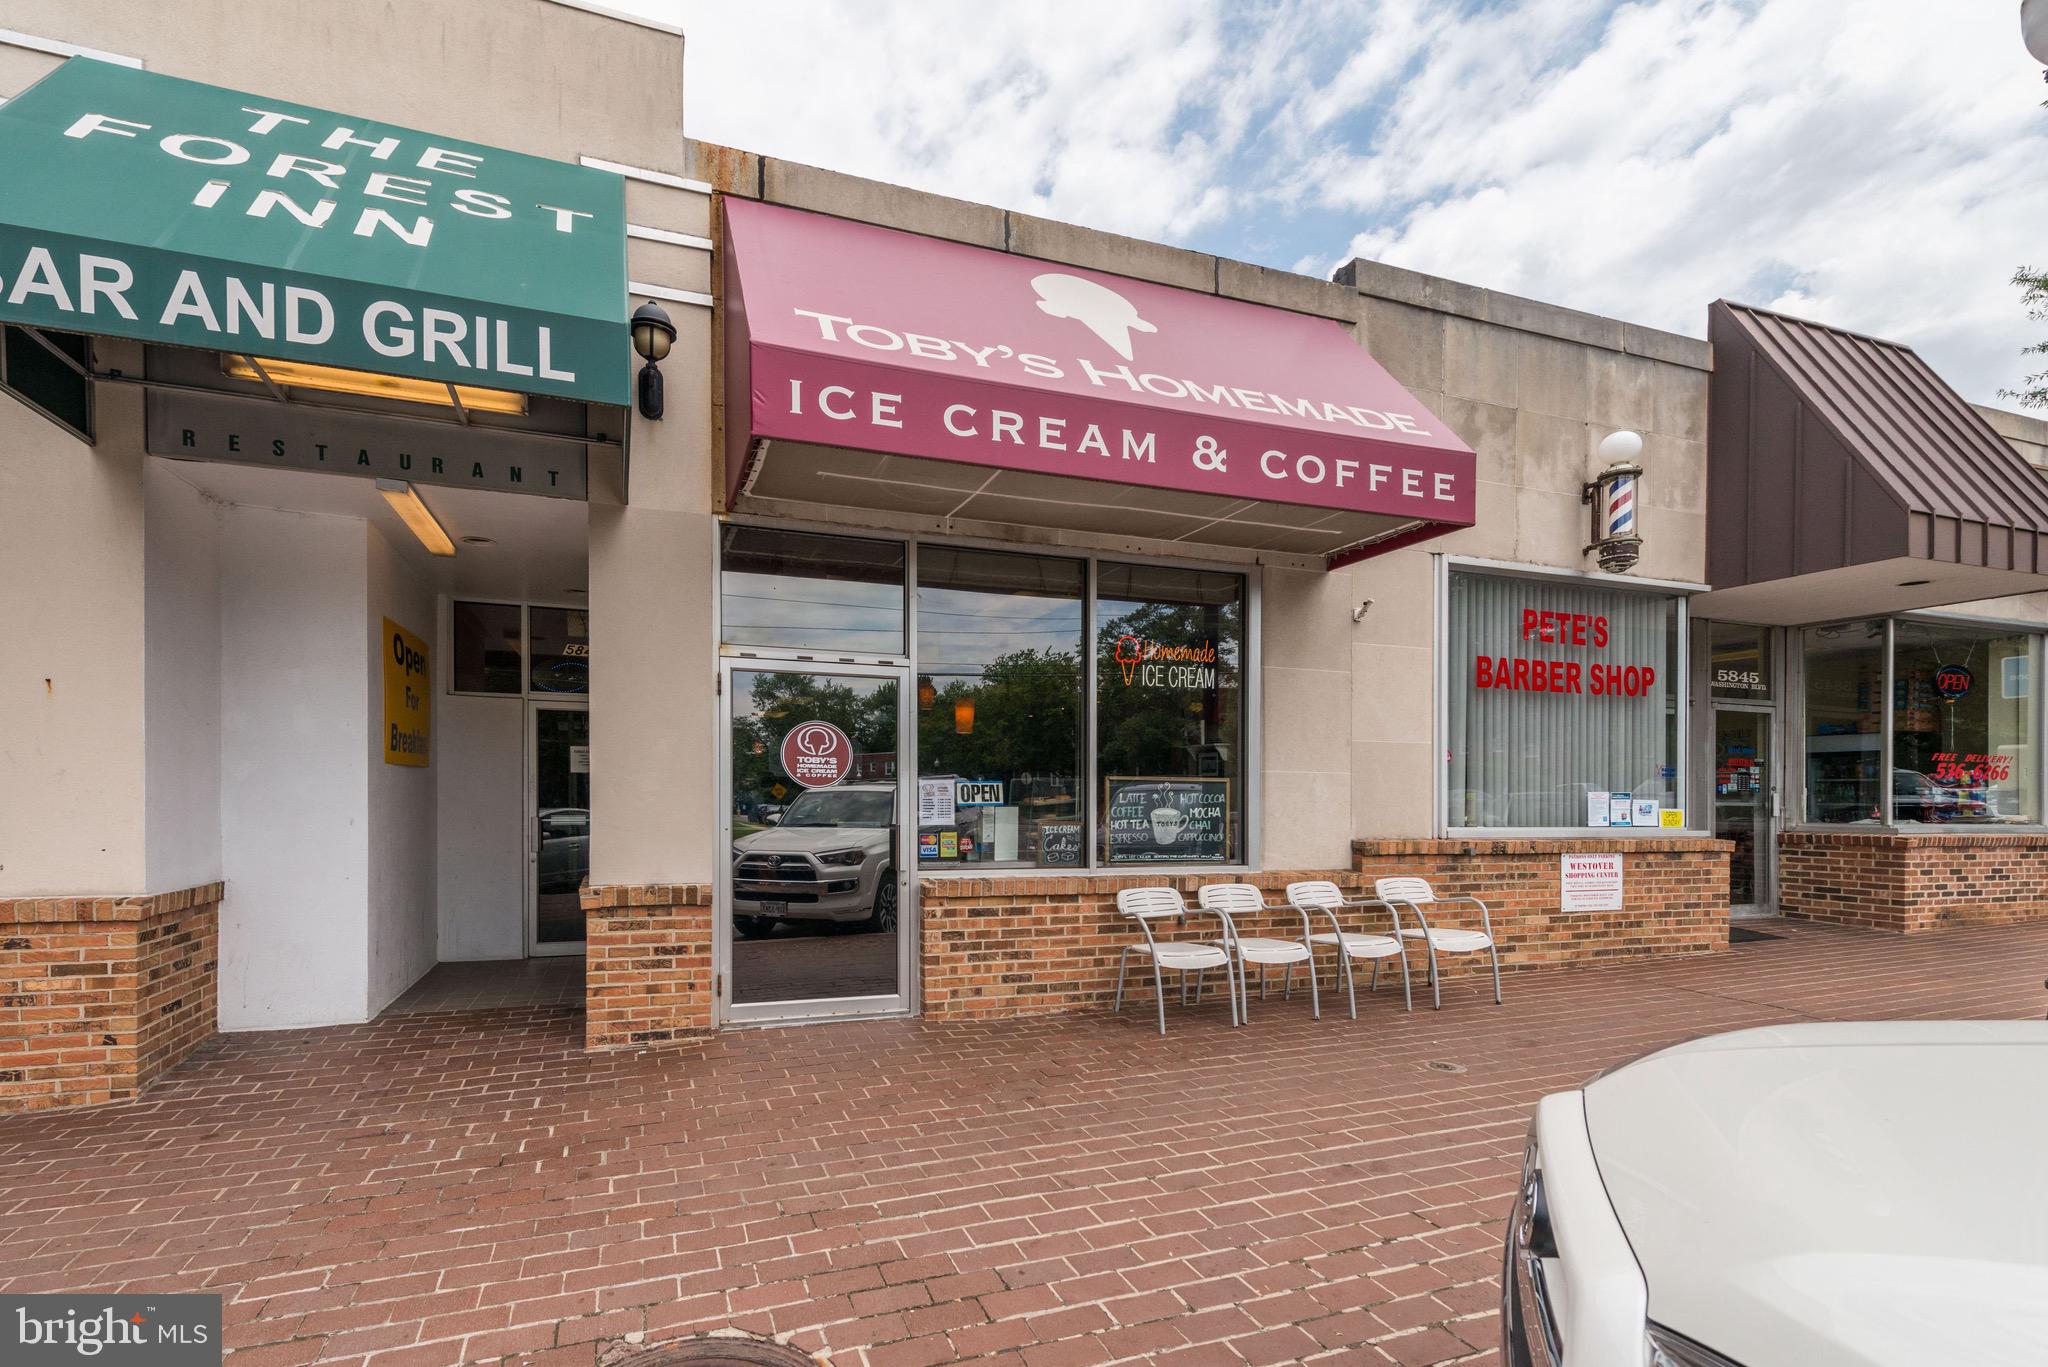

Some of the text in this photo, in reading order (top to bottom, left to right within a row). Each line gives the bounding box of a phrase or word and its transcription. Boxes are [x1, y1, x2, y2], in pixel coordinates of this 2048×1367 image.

[241, 106, 486, 179] THE
[63, 112, 594, 234] FOREST
[191, 179, 436, 248] INN
[0, 246, 577, 384] AR AND GRILL
[793, 307, 1433, 438] TOBY'S HOMEMADE
[788, 379, 1458, 503] ICE CREAM & COFFEE
[182, 428, 561, 488] RESTAURANT
[1522, 607, 1609, 649] PETE'S
[392, 632, 427, 677] Open
[1143, 640, 1216, 664] Homemade
[1142, 664, 1216, 690] ICE CREAM
[1476, 655, 1656, 698] BARBER SHOP
[1711, 681, 1749, 690] WASHINGTON
[1717, 669, 1760, 684] 5845
[1937, 673, 1970, 691] OPEN
[405, 685, 422, 713] For
[390, 722, 430, 754] Break
[796, 756, 838, 764] TOBY'S
[1931, 752, 2015, 764] FREE DELIVERY!
[960, 784, 1001, 803] OPEN
[1199, 793, 1226, 804] COCOA
[1111, 806, 1145, 818] COFFEE
[1189, 807, 1222, 819] MOCHA
[1110, 819, 1150, 831] HOT TEA
[1189, 820, 1211, 830] CHAI
[1043, 834, 1080, 851] Cakes
[1110, 832, 1149, 844] ESPRESSO
[1570, 861, 1614, 871] WESTOVER
